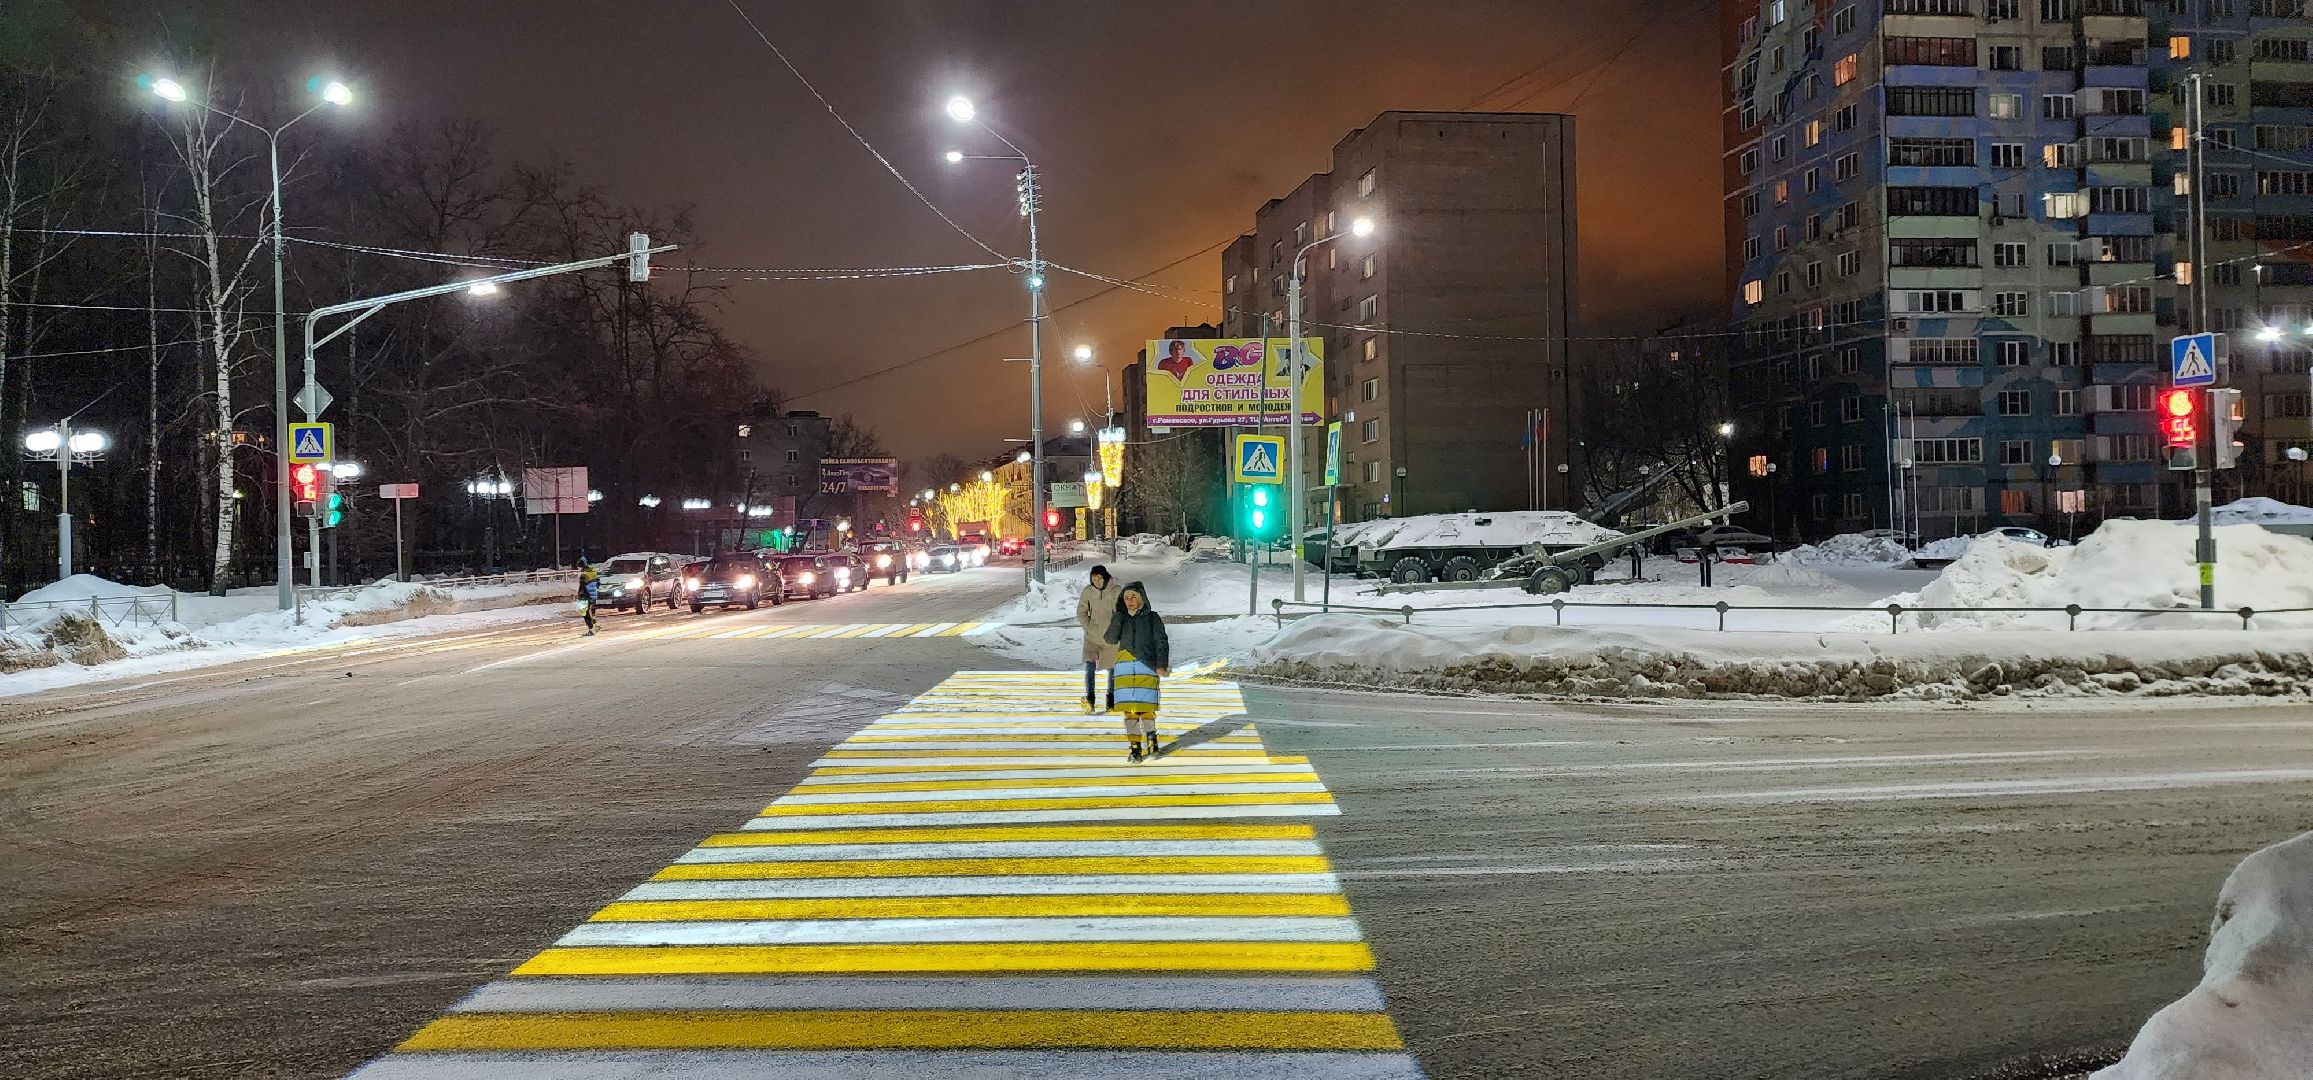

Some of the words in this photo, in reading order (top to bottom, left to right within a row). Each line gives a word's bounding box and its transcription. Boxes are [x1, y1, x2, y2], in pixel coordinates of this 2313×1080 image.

[1182, 389, 1210, 402] ДЛЯ
[1175, 403, 1233, 413] ПОДРОСТКОВ
[1237, 404, 1244, 412] И
[1248, 402, 1291, 412] МОЛОДЕЖ
[821, 482, 847, 494] 24/7
